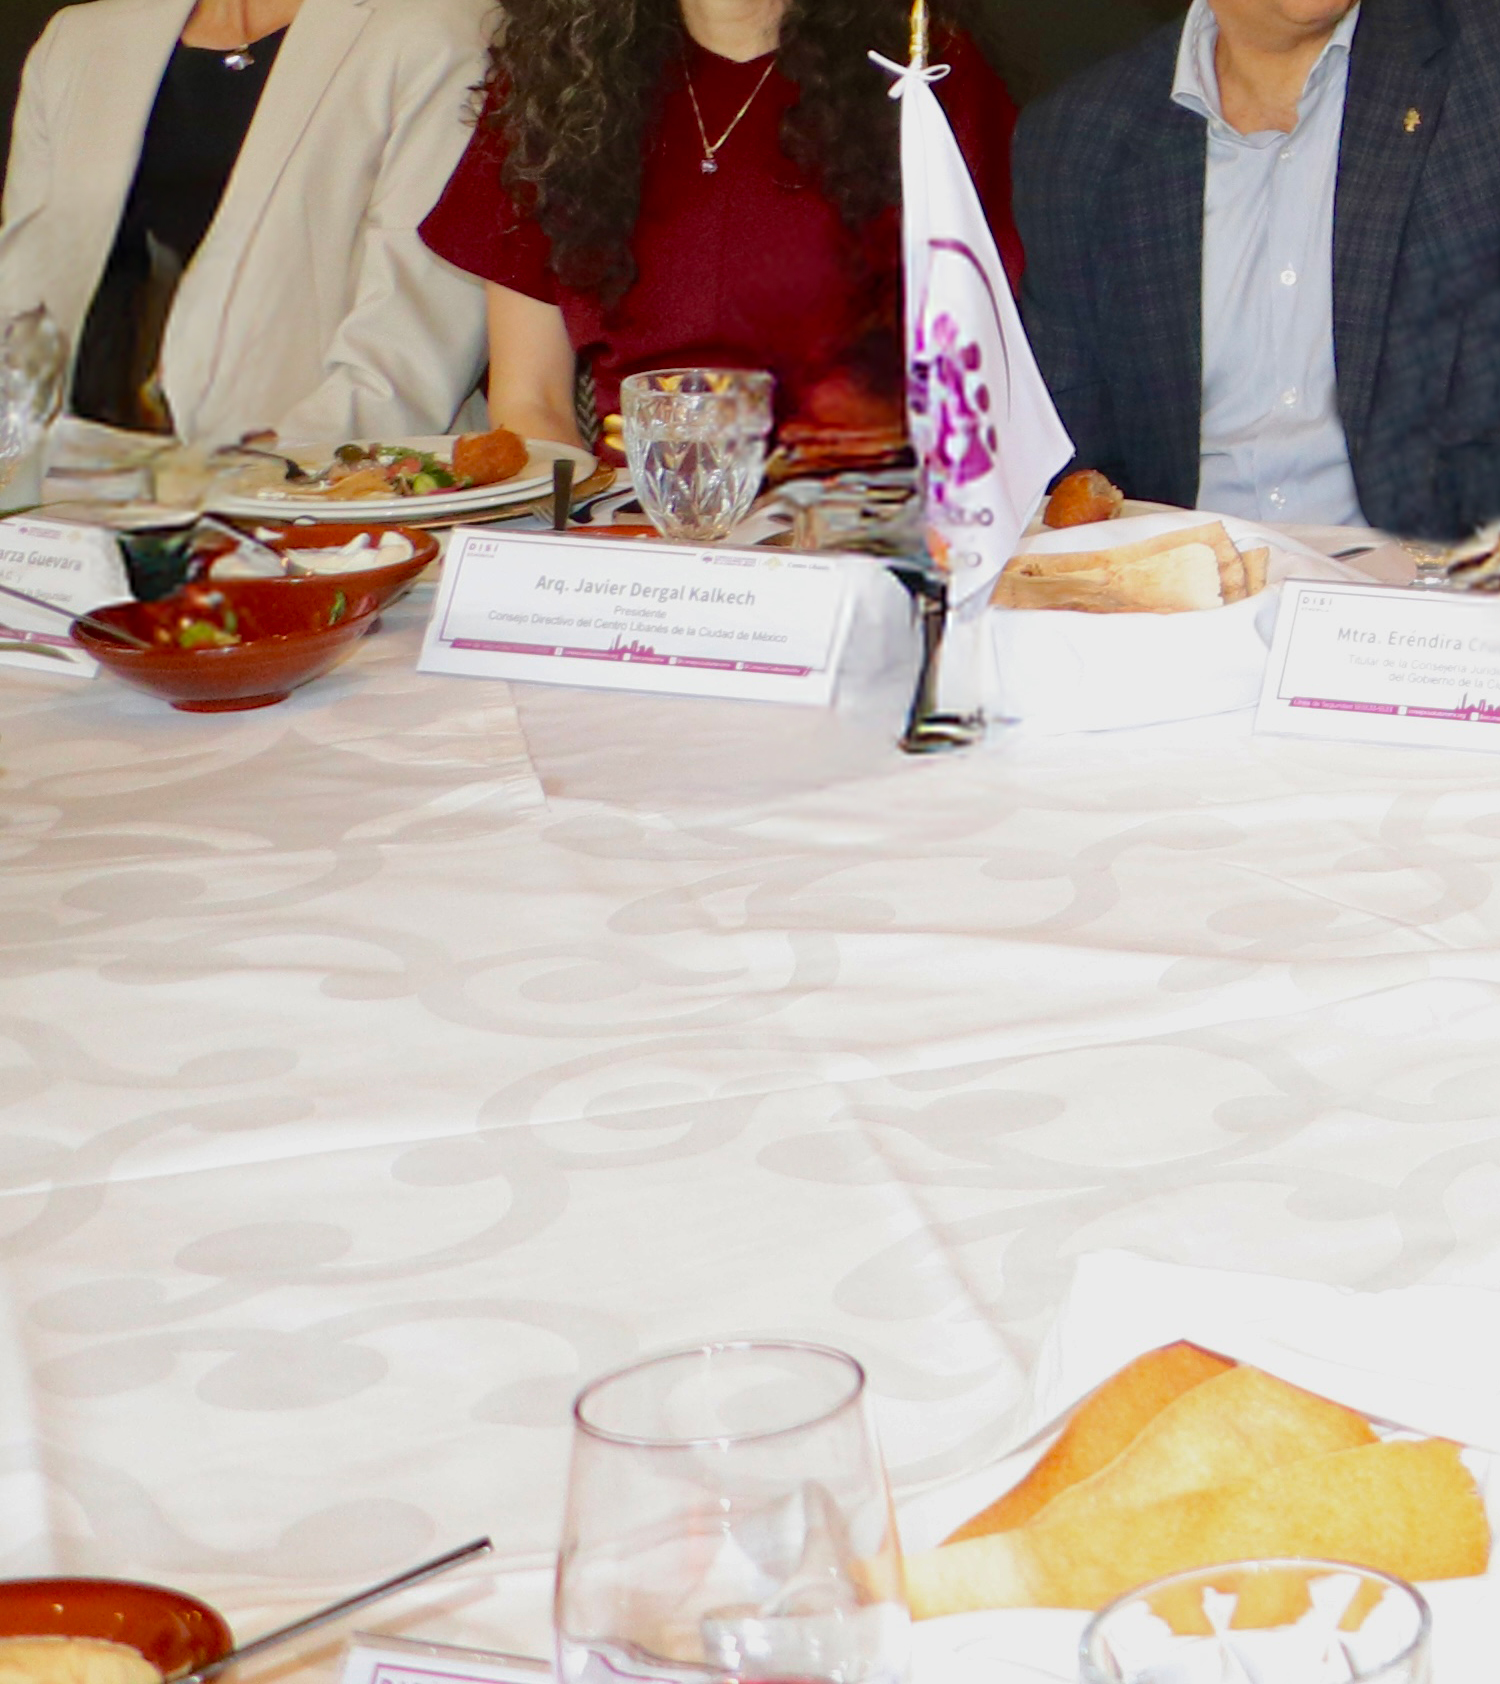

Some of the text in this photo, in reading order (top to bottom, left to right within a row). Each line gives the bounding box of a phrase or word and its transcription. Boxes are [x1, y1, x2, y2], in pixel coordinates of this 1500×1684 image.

[535, 575, 756, 607] Arq. Javier Dergal Kalkech
[613, 605, 667, 619] Presidente
[488, 610, 528, 624] Consejo
[531, 613, 574, 626] Directivo
[577, 617, 592, 628] del
[594, 618, 627, 631] Centro
[671, 625, 685, 636] de
[687, 626, 697, 636] la
[699, 626, 734, 639] Ciudad
[737, 630, 750, 641] de
[752, 632, 788, 644] México
[1337, 627, 1382, 645] Mtra.
[1388, 629, 1463, 651] Eréndira
[1383, 658, 1395, 668] de
[1458, 676, 1472, 687] de
